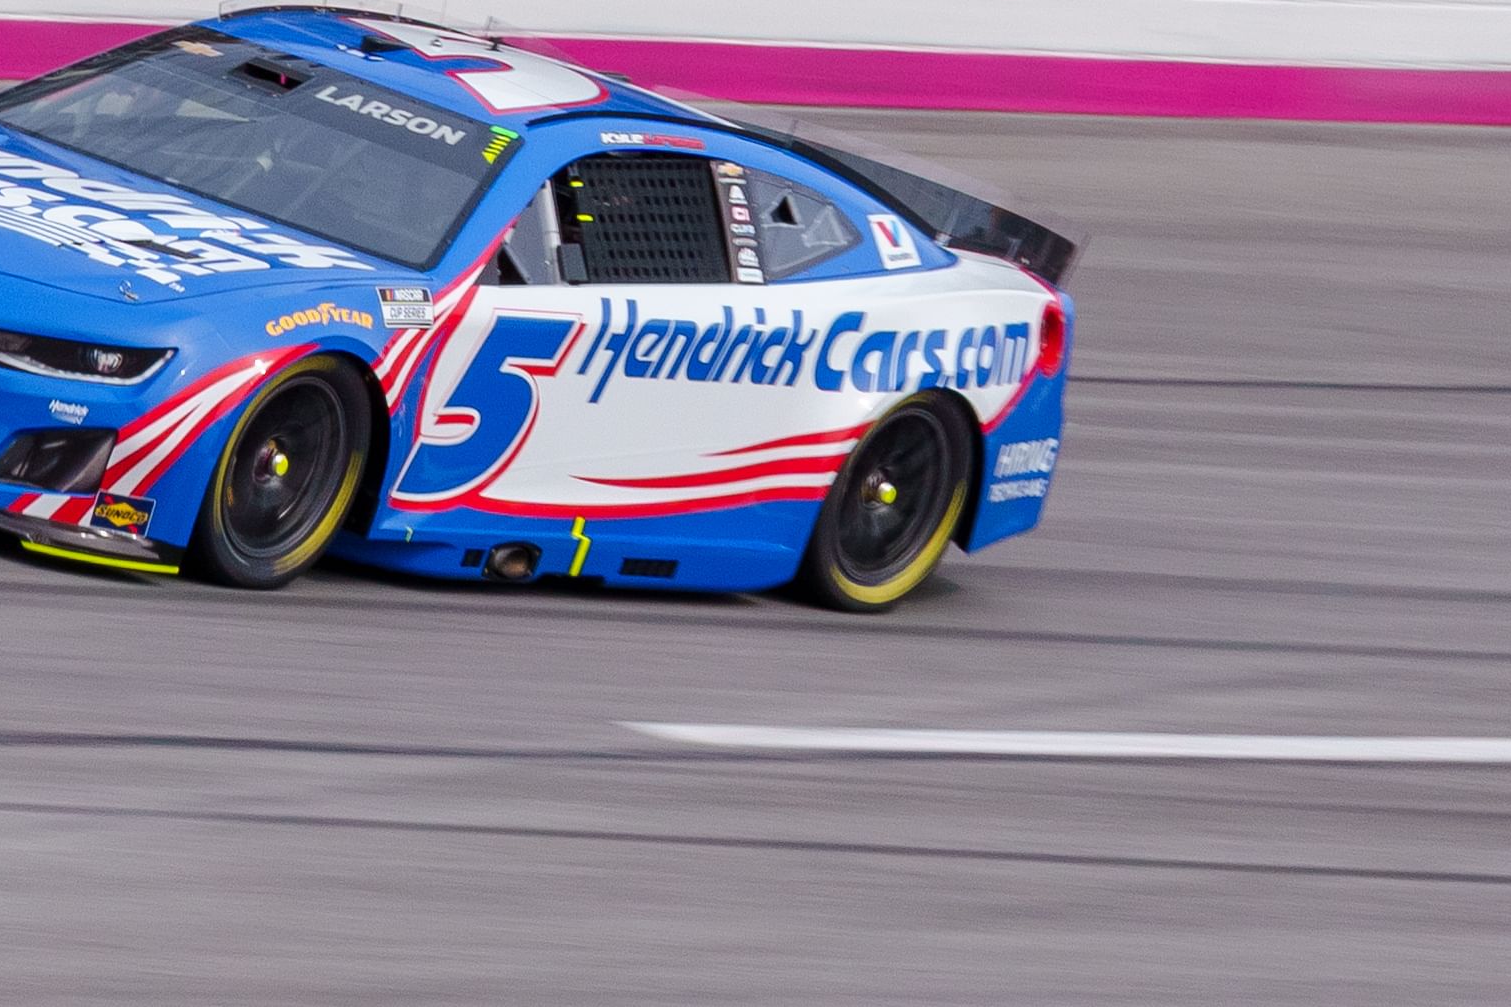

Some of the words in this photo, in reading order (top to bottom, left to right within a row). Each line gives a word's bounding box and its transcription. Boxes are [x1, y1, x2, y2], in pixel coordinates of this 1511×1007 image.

[315, 86, 466, 145] LARSON
[265, 303, 374, 336] GOODYEAR
[390, 306, 403, 319] CUP
[403, 307, 426, 320] SERIES
[577, 297, 1030, 403] HendrickCars.com
[49, 399, 89, 417] Hendrick
[389, 309, 586, 512] 5
[95, 504, 148, 525] SUNOCO
